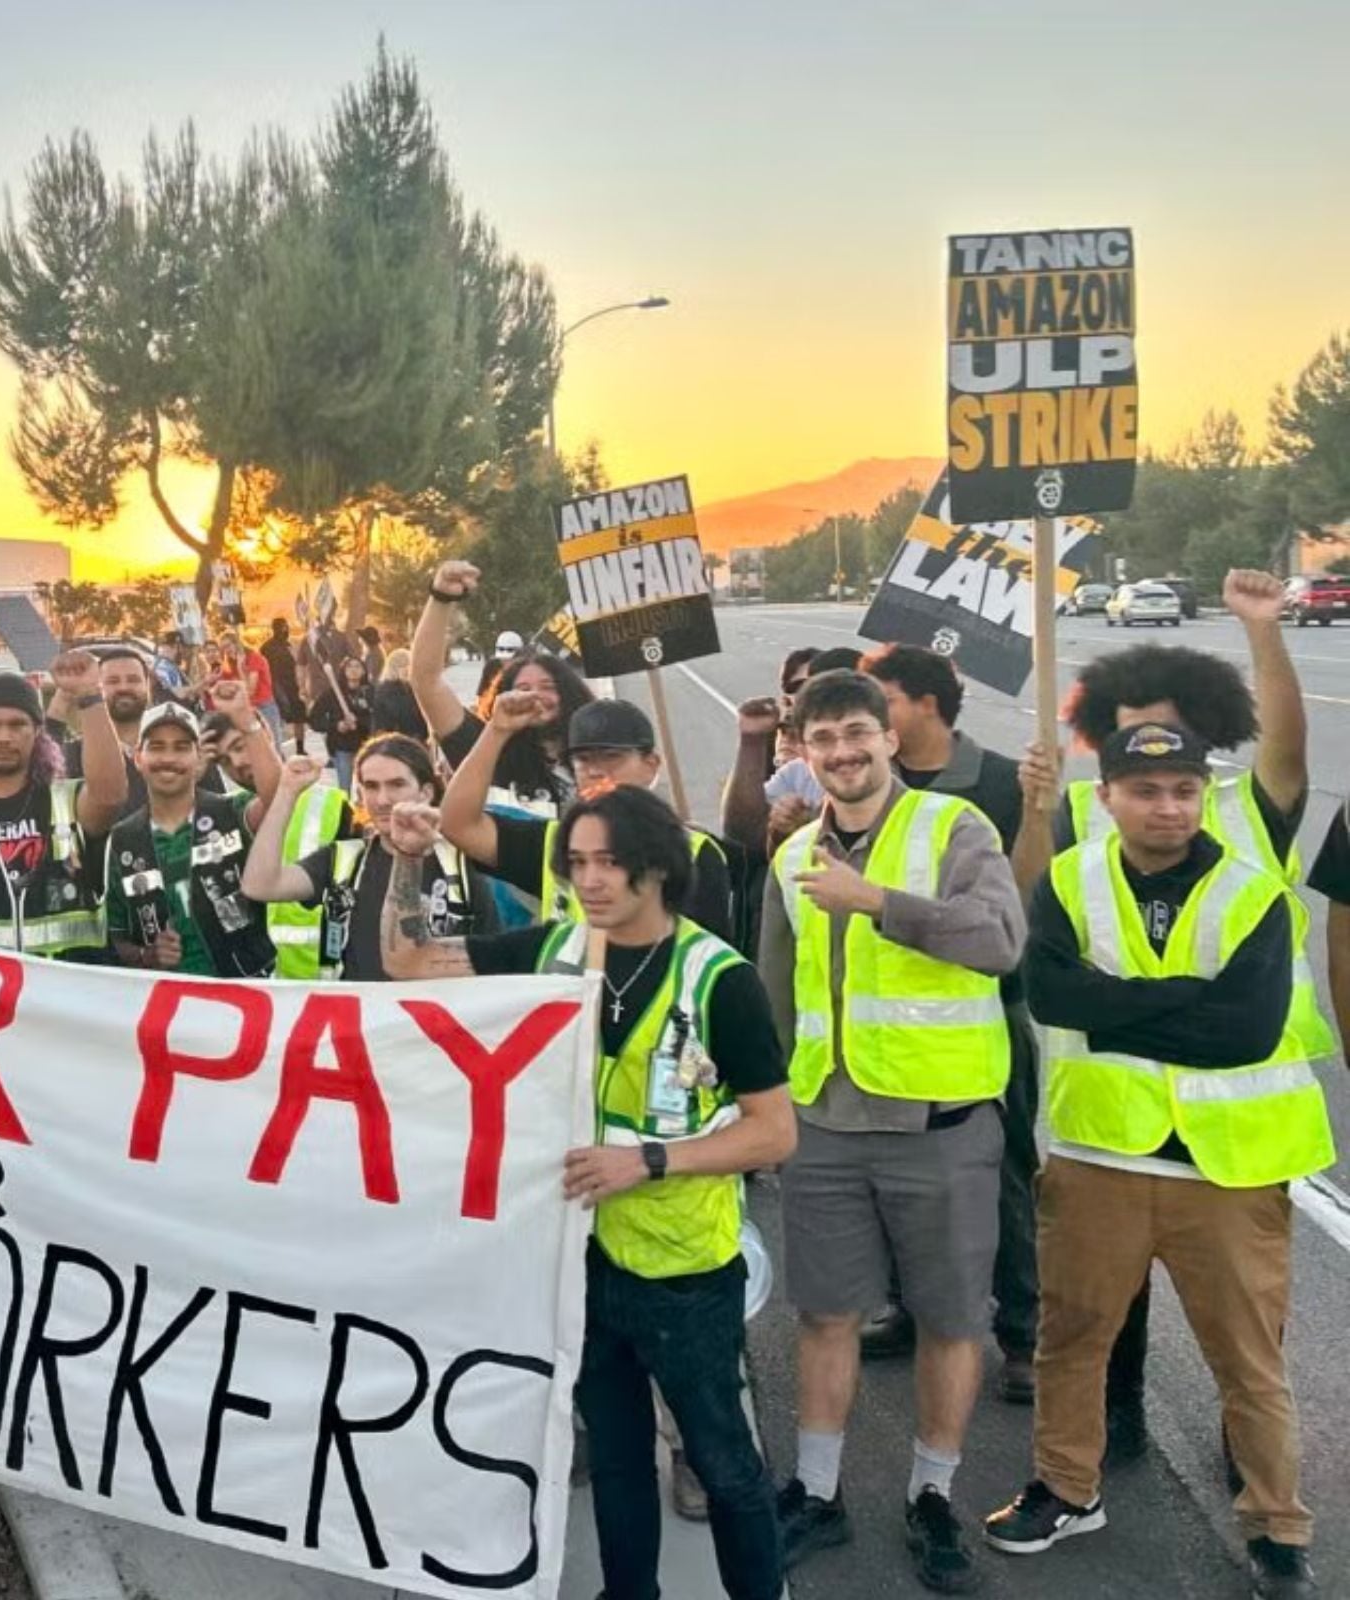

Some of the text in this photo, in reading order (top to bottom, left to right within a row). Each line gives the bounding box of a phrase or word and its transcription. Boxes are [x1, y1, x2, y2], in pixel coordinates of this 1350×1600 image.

[956, 231, 1130, 273] TANNC
[956, 271, 1131, 338] AMAZON
[950, 335, 1133, 393] ULP
[950, 385, 1139, 472] STRIKE
[561, 480, 688, 541] AMAZON
[618, 527, 642, 546] is
[564, 536, 711, 623] UNFAIR
[888, 539, 1068, 638] LAW
[129, 979, 582, 1220] PAY
